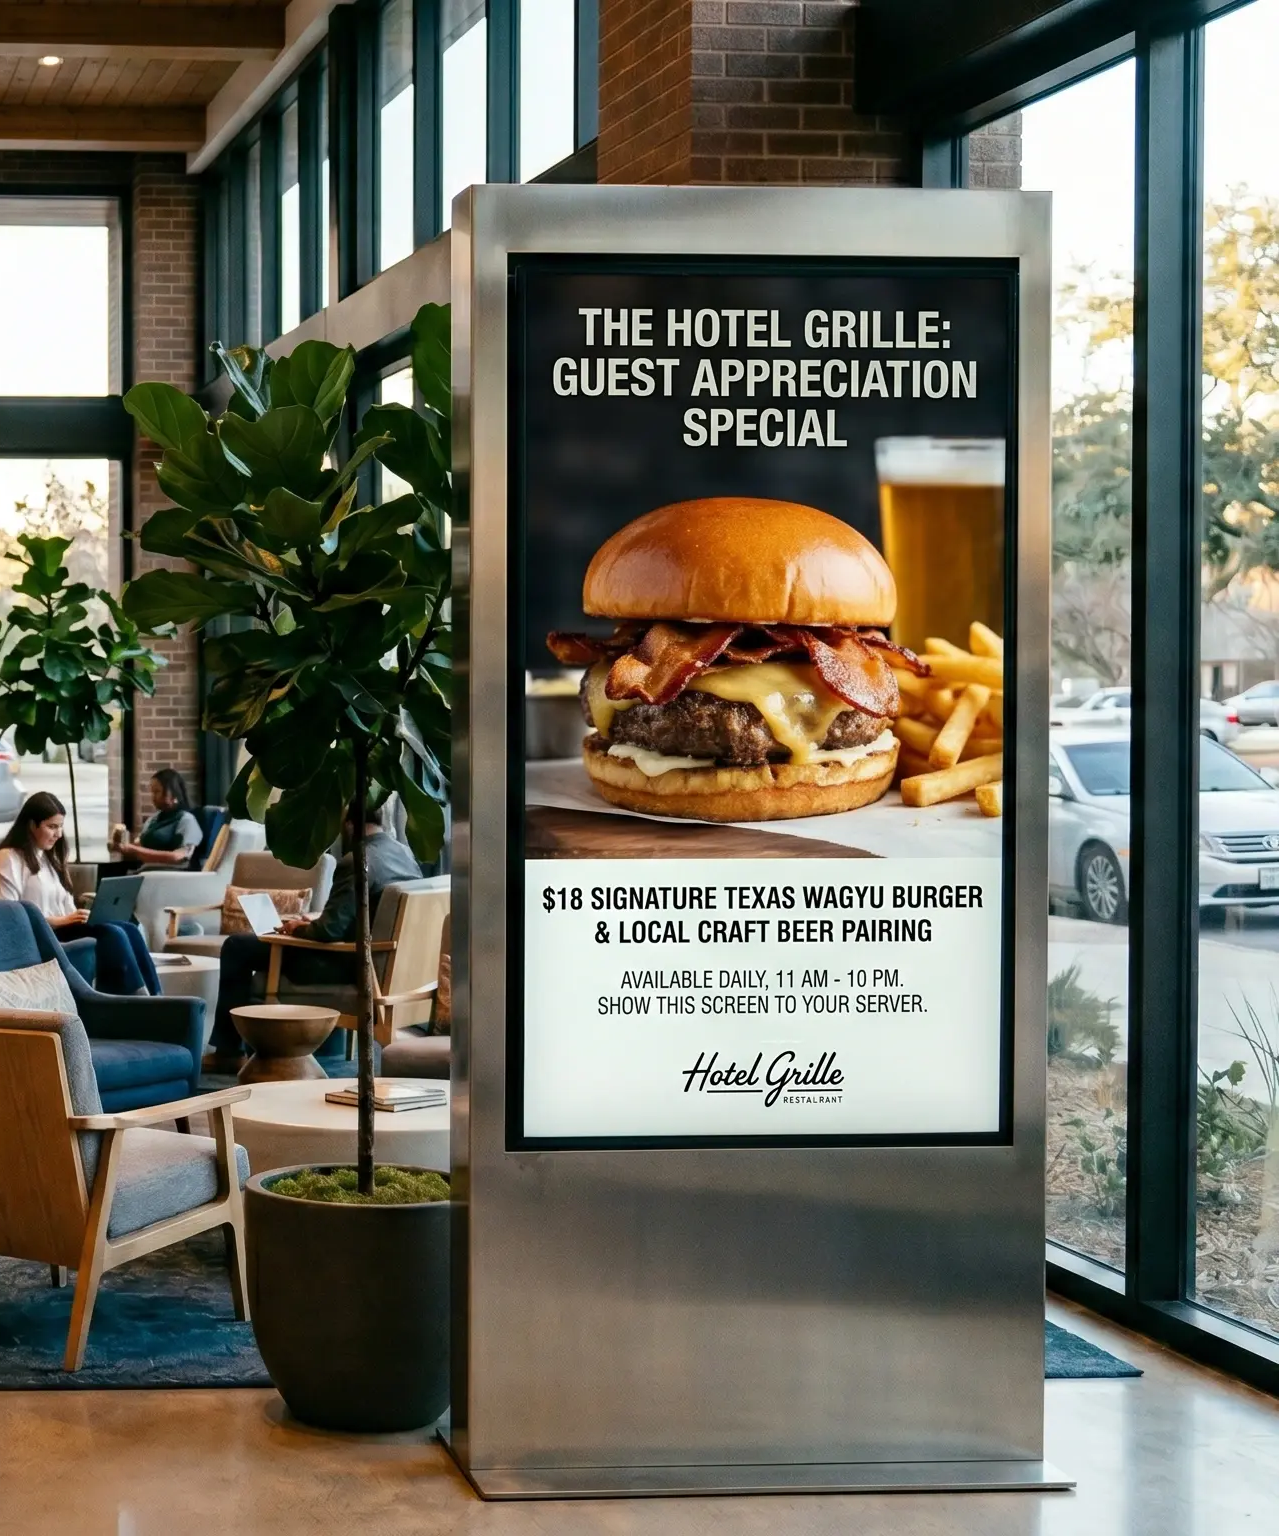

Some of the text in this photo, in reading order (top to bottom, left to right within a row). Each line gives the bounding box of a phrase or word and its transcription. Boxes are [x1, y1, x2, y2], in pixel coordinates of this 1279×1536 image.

[579, 308, 950, 348] THE HOTEL GRILLE:
[553, 357, 976, 398] GUEST APPRECIATION
[684, 408, 847, 446] SPECIAL
[543, 885, 983, 913] $18 SIGNATURE TEXAS WAGYU BURGER
[595, 919, 931, 943] & LOCAL CRAFT BEER PAIRING
[621, 971, 712, 988] AVAILABLE
[720, 970, 768, 990] DAILY,
[776, 970, 793, 988] 11
[801, 970, 827, 987] AM
[848, 970, 866, 987] 10
[873, 969, 903, 987] PM.
[598, 995, 927, 1015] SHOW THIS SCREEN TO YOUR SERVER.
[682, 1051, 845, 1108] Hotel Grille
